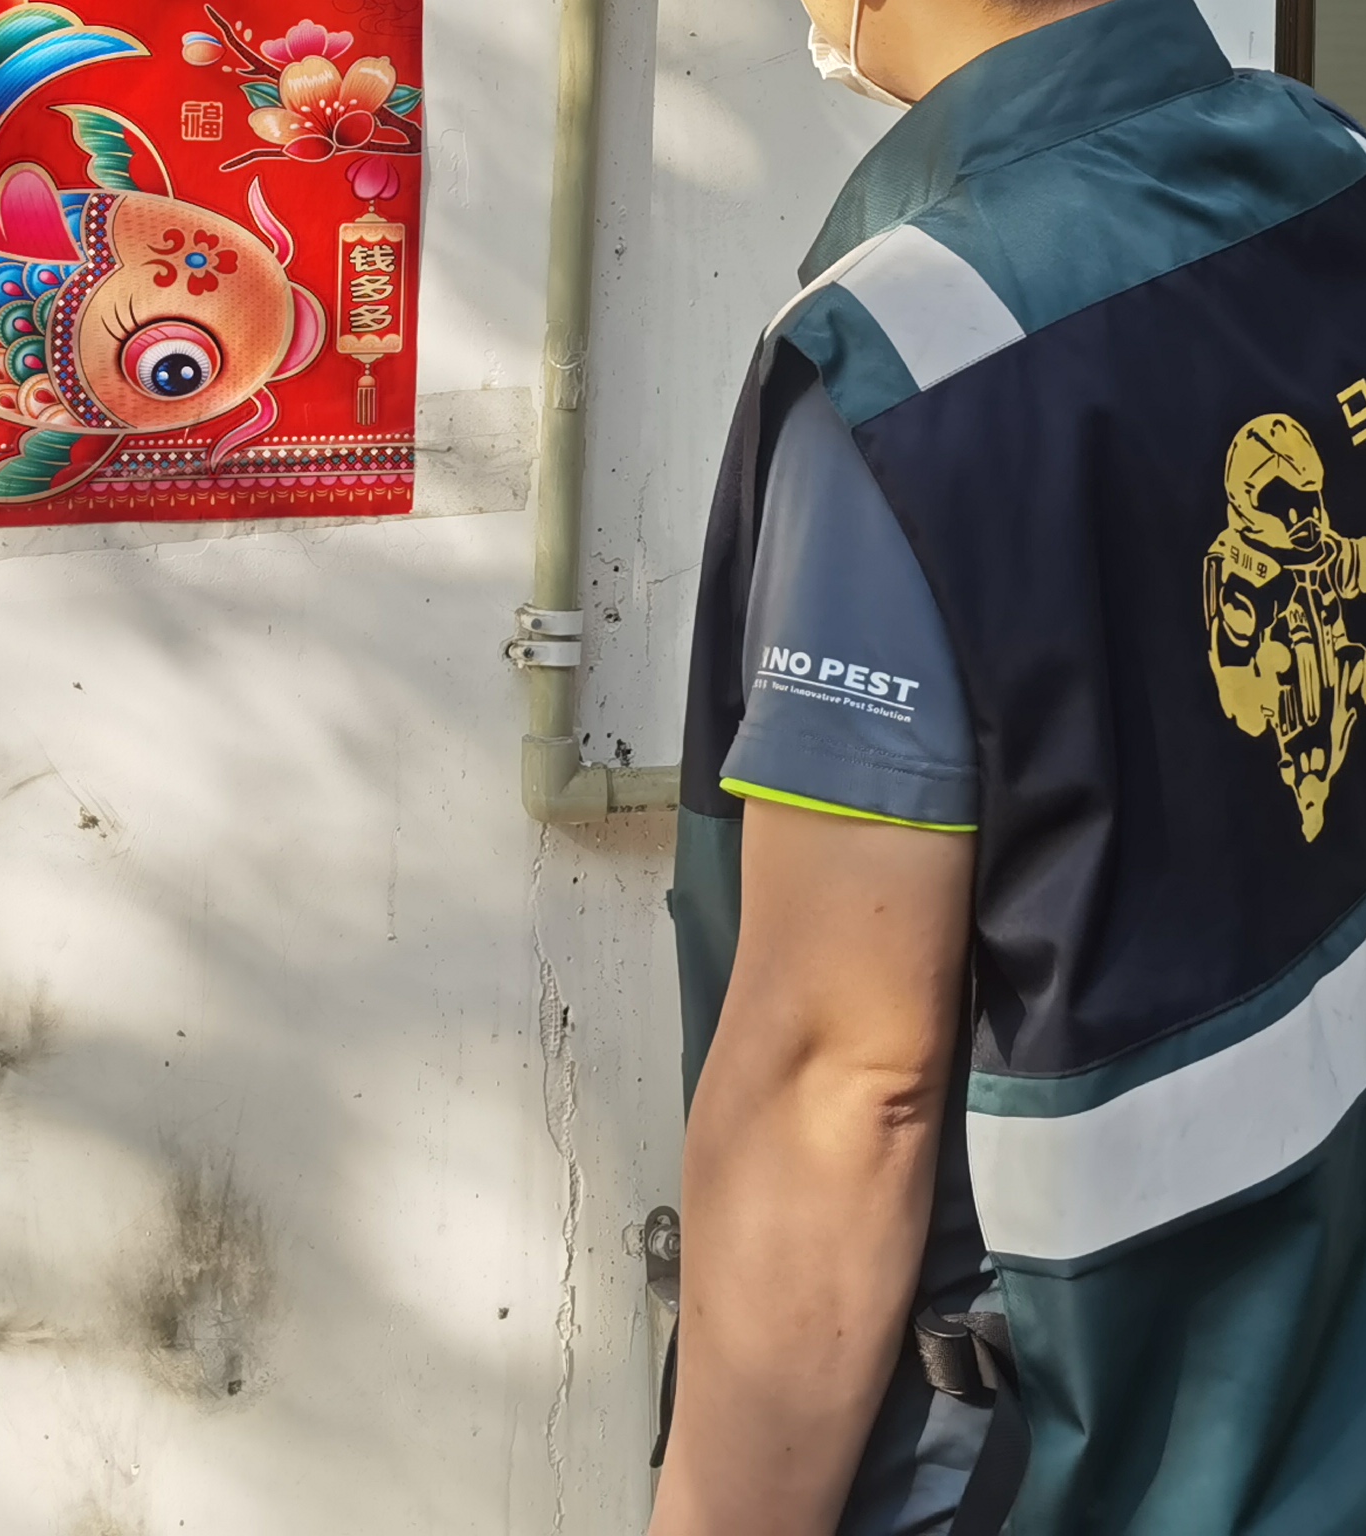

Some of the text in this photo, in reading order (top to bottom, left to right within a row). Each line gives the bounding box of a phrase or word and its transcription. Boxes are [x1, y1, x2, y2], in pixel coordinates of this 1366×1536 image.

[182, 102, 223, 140] 福
[349, 245, 395, 333] 钱多多
[818, 657, 920, 703] PEST
[790, 684, 842, 704] Innovative
[843, 696, 866, 711] Pest
[866, 704, 912, 724] Solution
